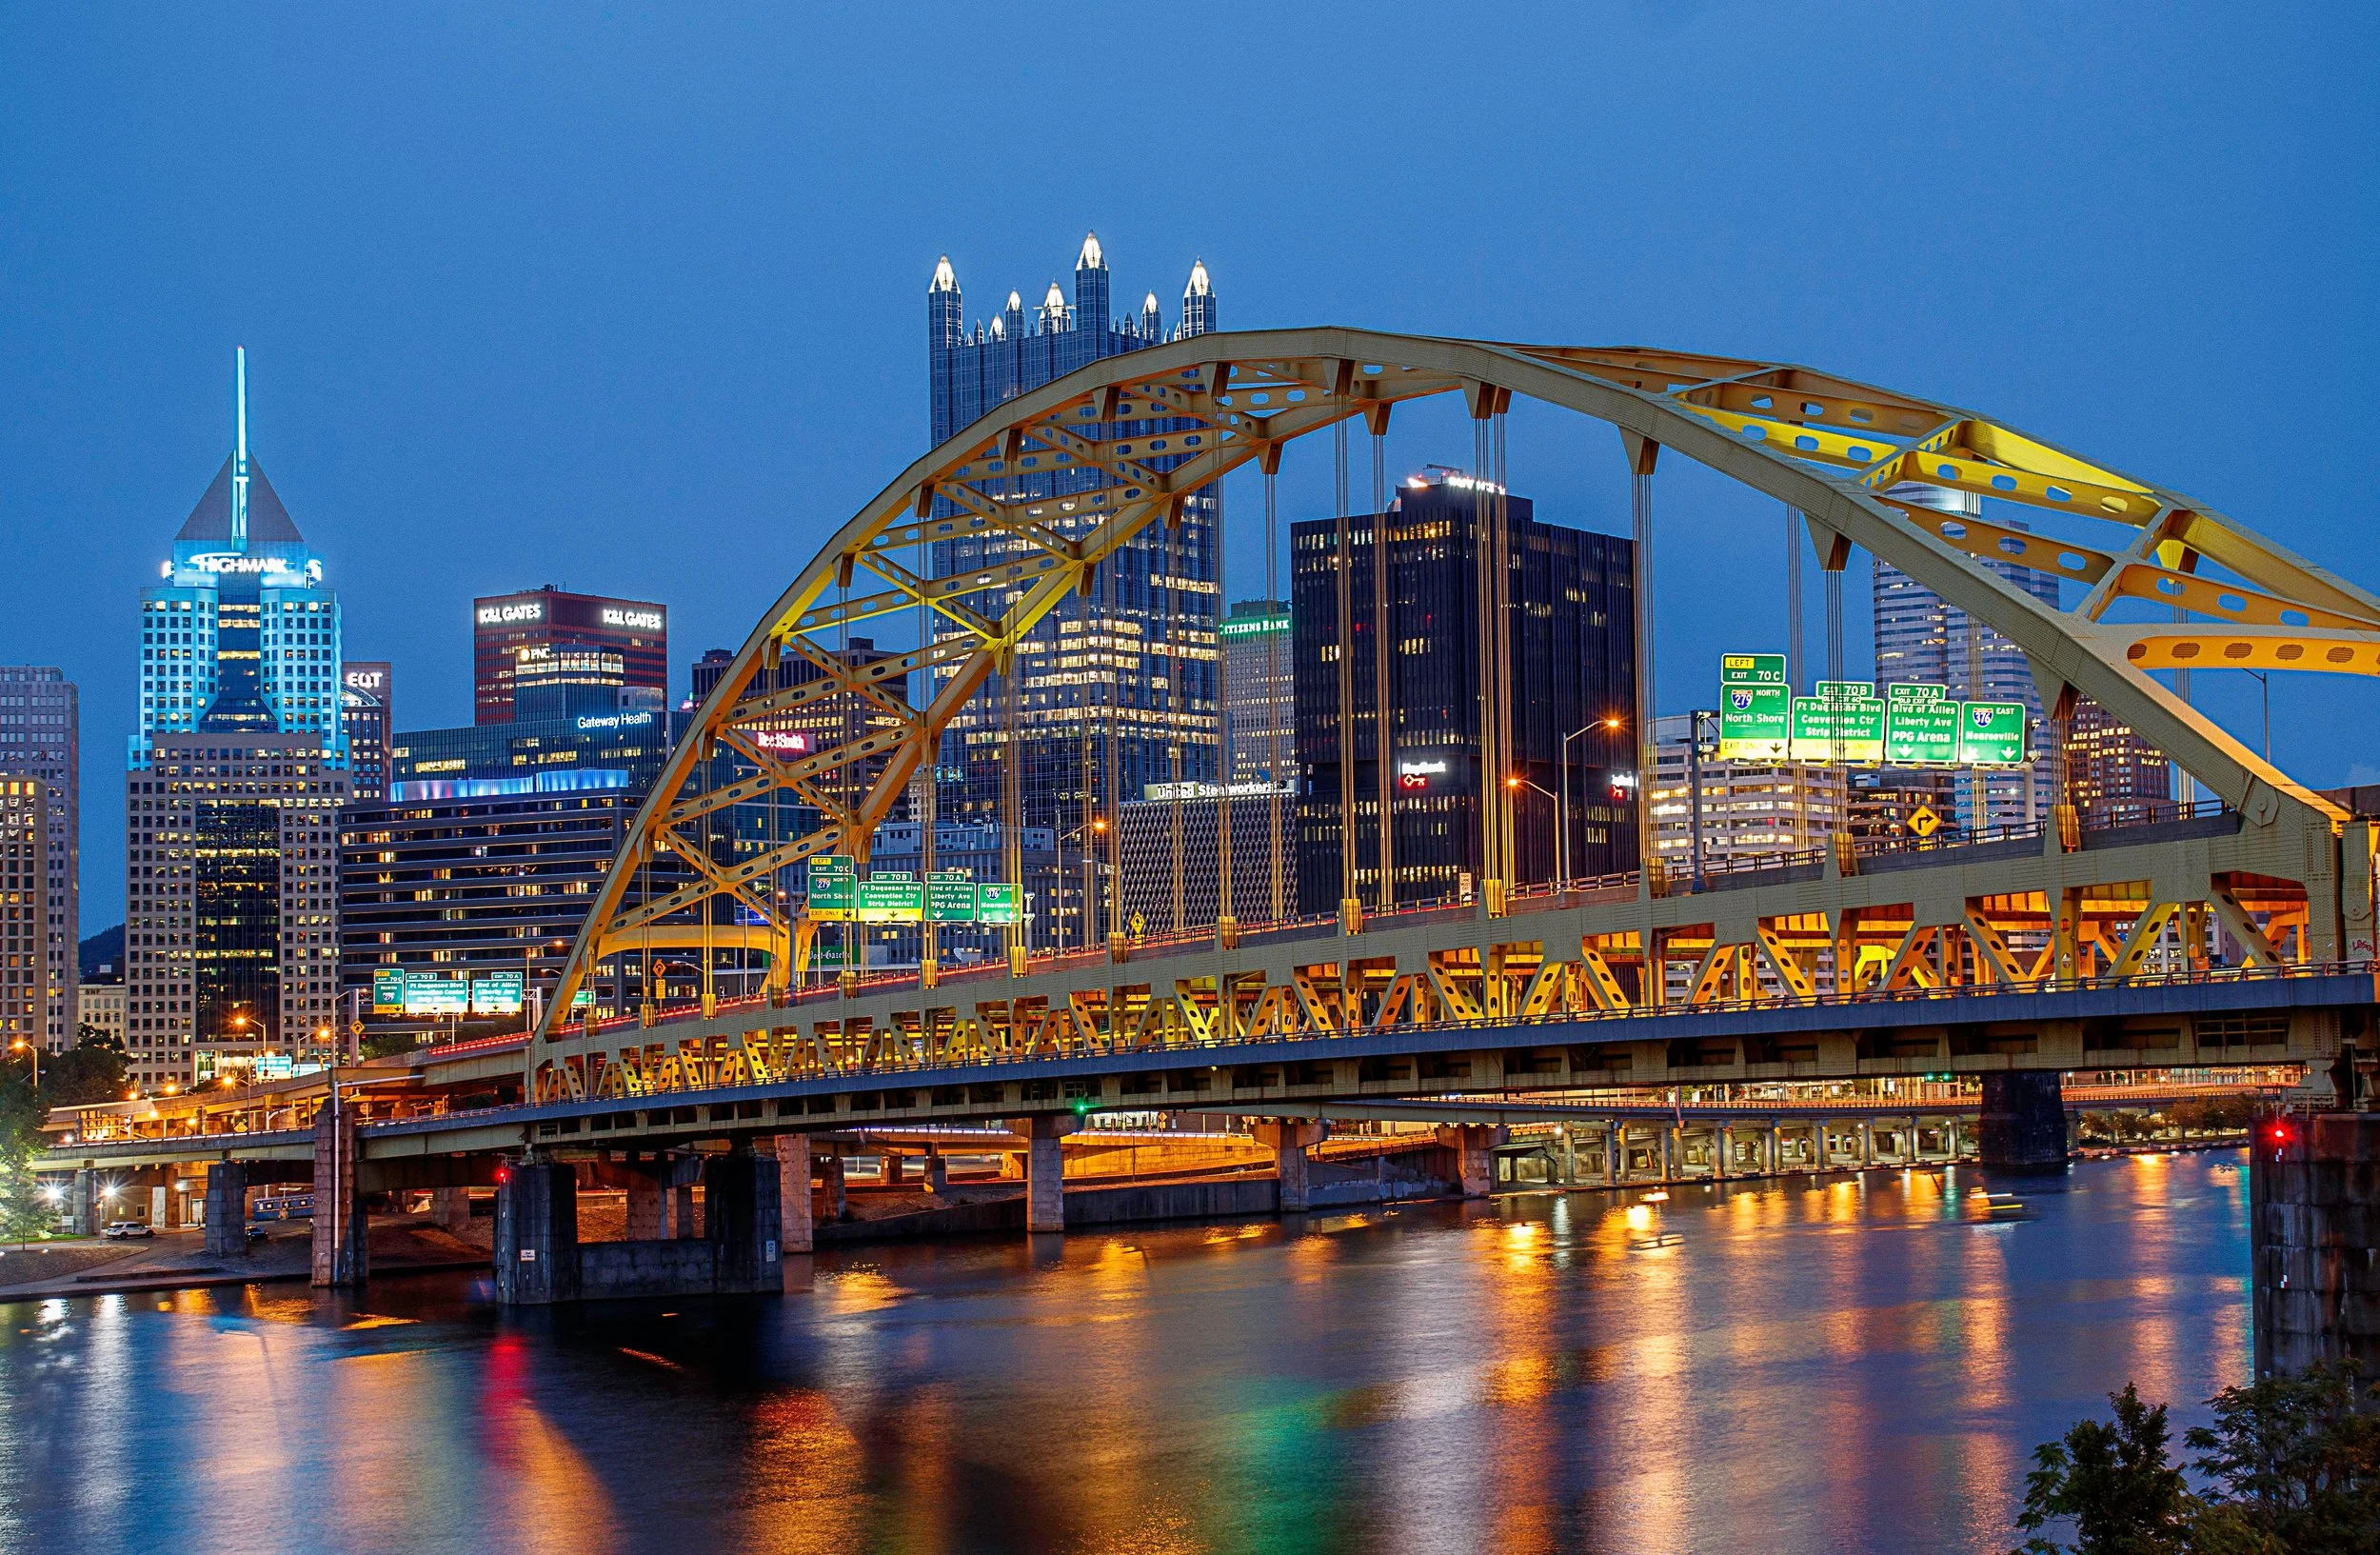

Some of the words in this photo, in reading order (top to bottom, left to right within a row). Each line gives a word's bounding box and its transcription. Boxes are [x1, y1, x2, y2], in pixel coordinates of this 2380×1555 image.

[197, 556, 288, 573] HIGHMARK
[479, 607, 502, 624] K&L
[502, 604, 541, 621] GATES
[603, 608, 625, 625] K&L
[625, 611, 662, 629] GATES
[1262, 619, 1290, 631] BANK
[531, 648, 550, 659] PNC
[1729, 659, 1750, 668] LEFT
[347, 671, 383, 688] EQT
[1735, 694, 1752, 706] 279
[1797, 702, 1807, 711] Ft
[1859, 703, 1881, 712] Blvd
[1893, 704, 1914, 713] Blvd
[1916, 705, 1925, 713] of
[1929, 705, 1955, 715] Allies
[577, 715, 620, 729] Gateway
[621, 711, 651, 725] Health
[1726, 713, 1753, 724] North
[1756, 713, 1784, 724] Shore
[1859, 716, 1875, 726] Ctr
[1895, 716, 1930, 728] Liberty
[1934, 717, 1953, 728] Ave
[1975, 711, 1991, 724] 376
[1805, 727, 1830, 738] Strip
[1893, 730, 1914, 742] PPG
[1916, 731, 1951, 743] Arena
[1965, 730, 2019, 741] Monroeville
[1158, 784, 1195, 800] United
[809, 949, 850, 962] Pot-Gazete
